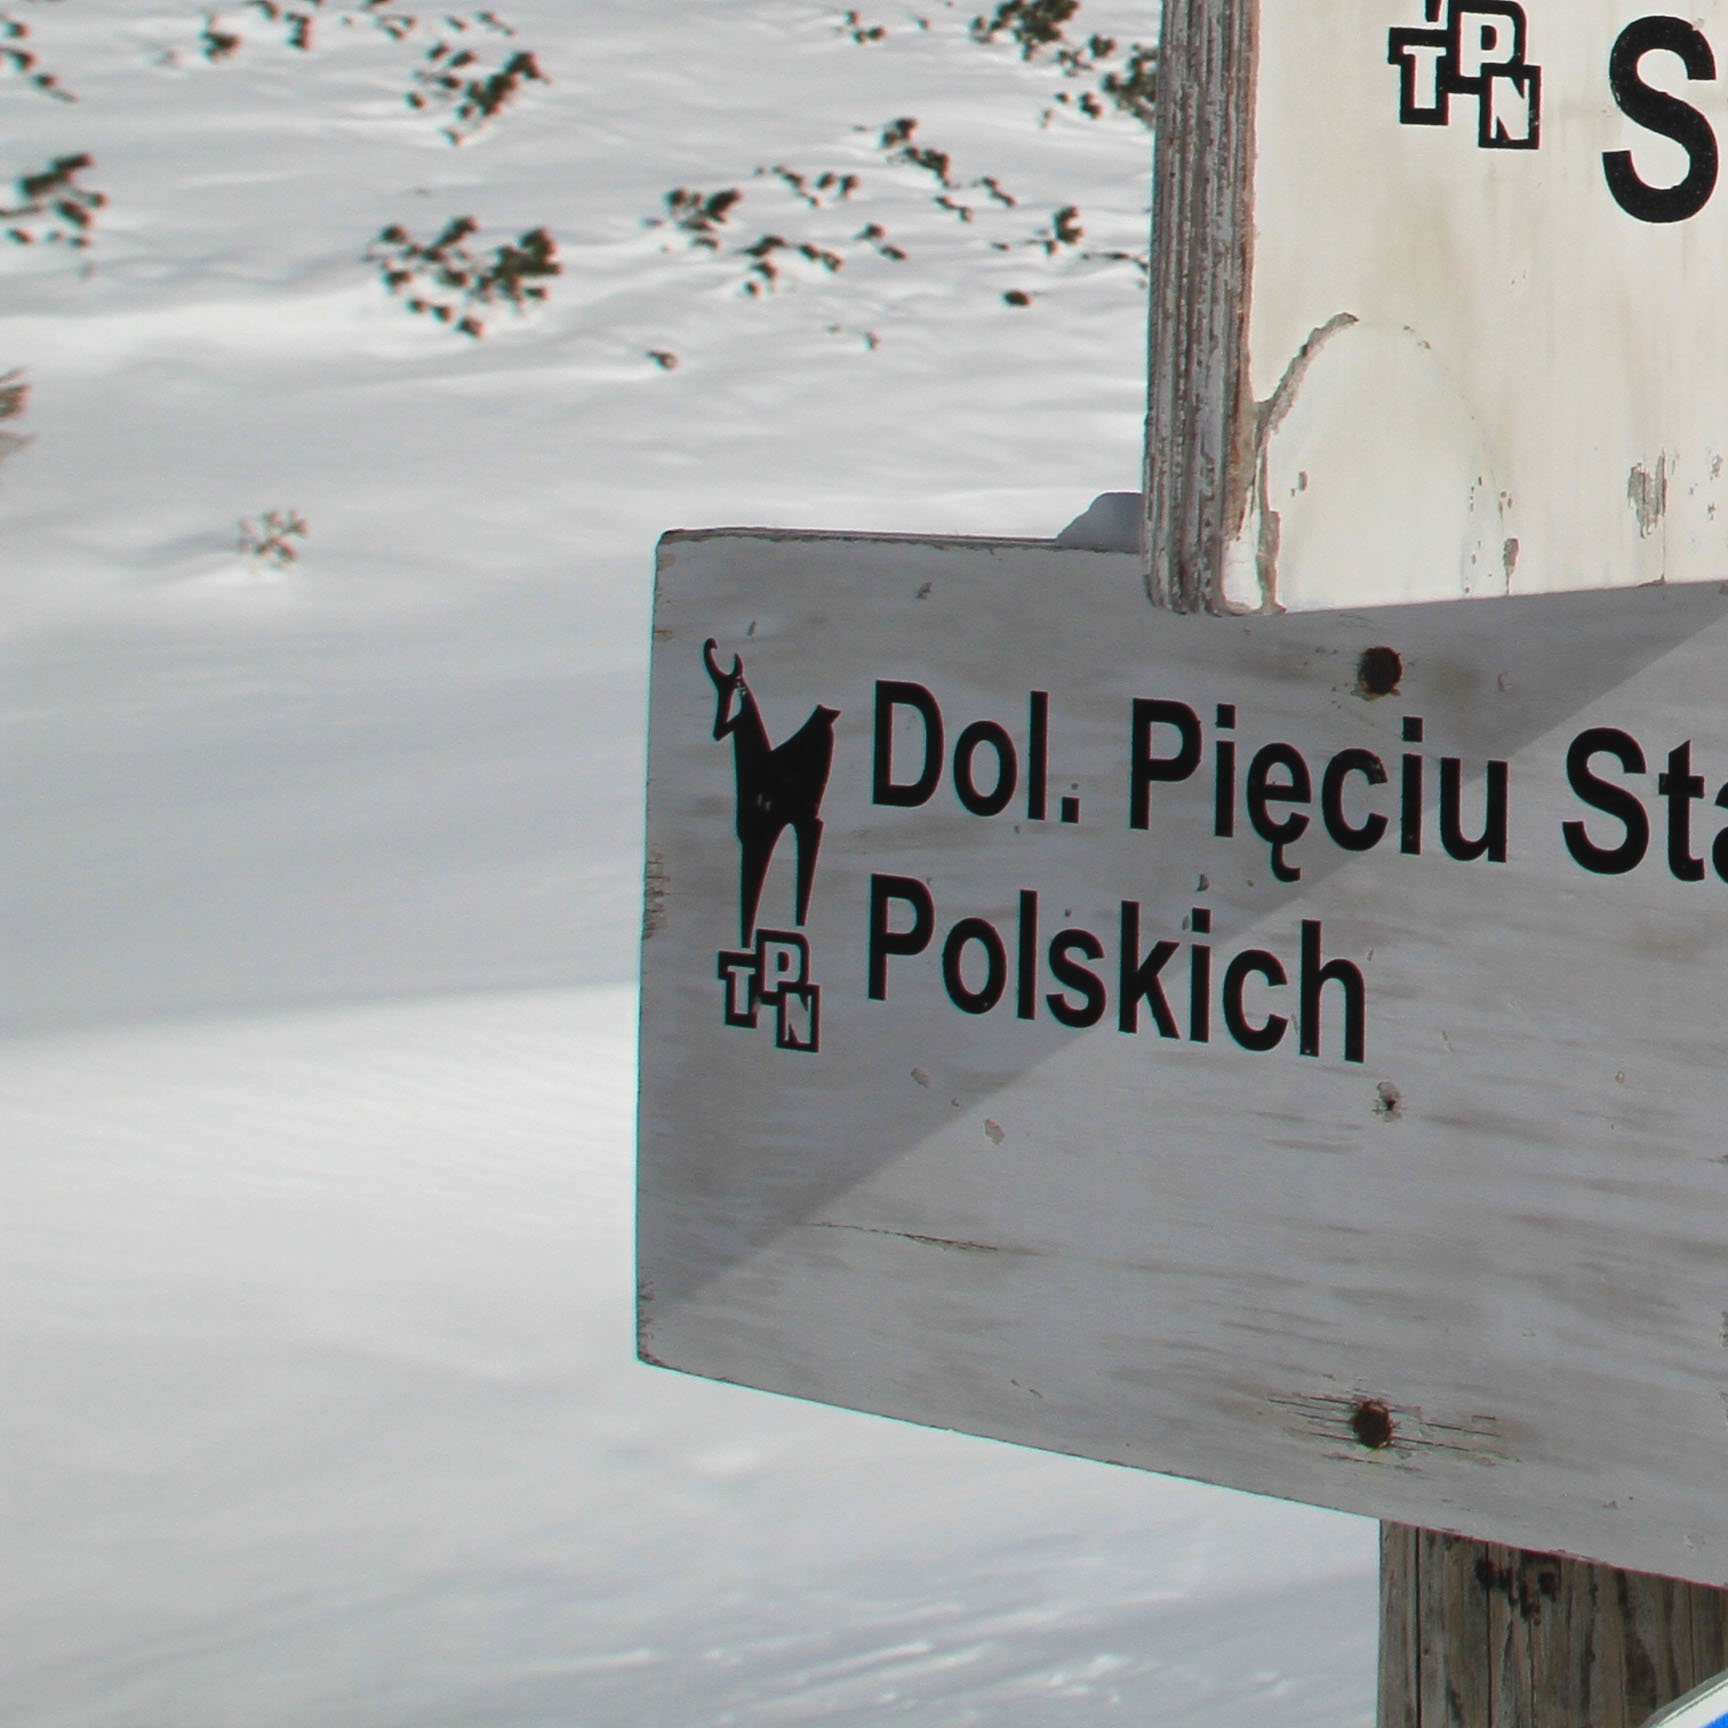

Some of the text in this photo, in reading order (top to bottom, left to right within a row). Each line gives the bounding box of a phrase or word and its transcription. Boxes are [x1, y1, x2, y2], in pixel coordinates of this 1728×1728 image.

[873, 681, 1078, 823] Dol.
[1130, 697, 1507, 882] Pięciu
[718, 928, 818, 1052] TPN
[869, 876, 1364, 1063] Polskich
